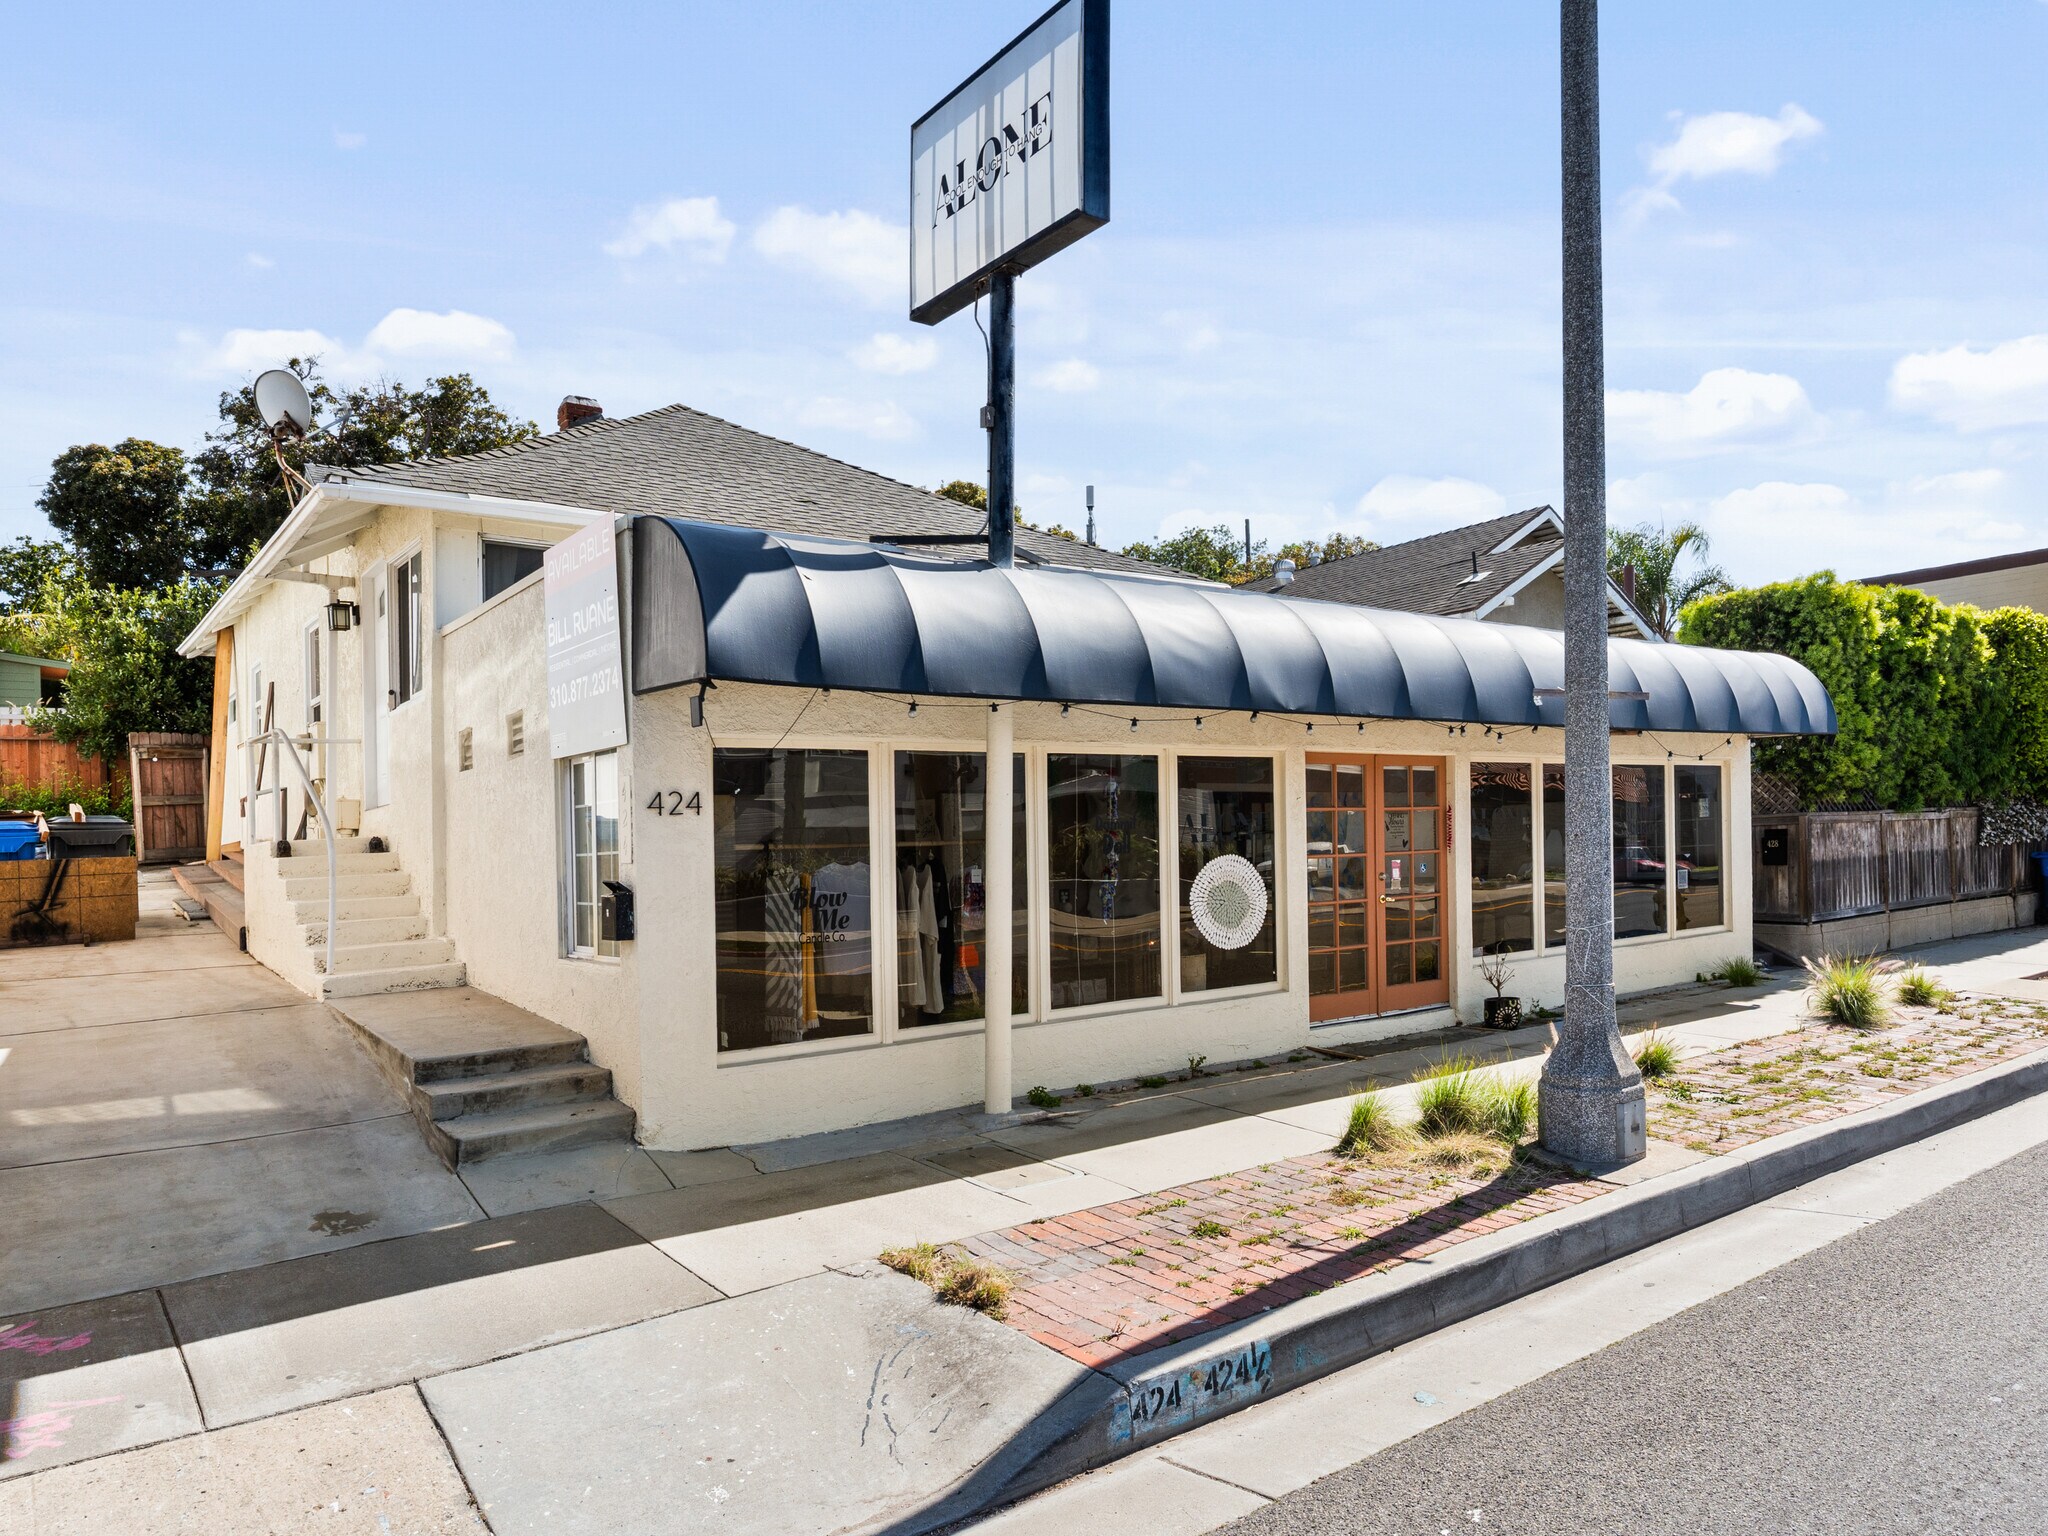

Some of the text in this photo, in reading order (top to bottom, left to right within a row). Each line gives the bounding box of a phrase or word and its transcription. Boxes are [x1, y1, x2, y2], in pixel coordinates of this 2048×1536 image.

[932, 91, 1053, 229] ALONE
[944, 123, 1043, 205] COOL ENOUGH TO HANG
[547, 528, 610, 583] AVAILABLE
[548, 594, 616, 648] BILL RUANE
[550, 665, 619, 709] 310.877.2374
[646, 790, 703, 817] 424
[1766, 839, 1779, 848] 428
[790, 886, 848, 910] Blow
[813, 908, 850, 931] Me
[799, 930, 847, 944] Candle Co.
[1132, 1379, 1182, 1423] 424
